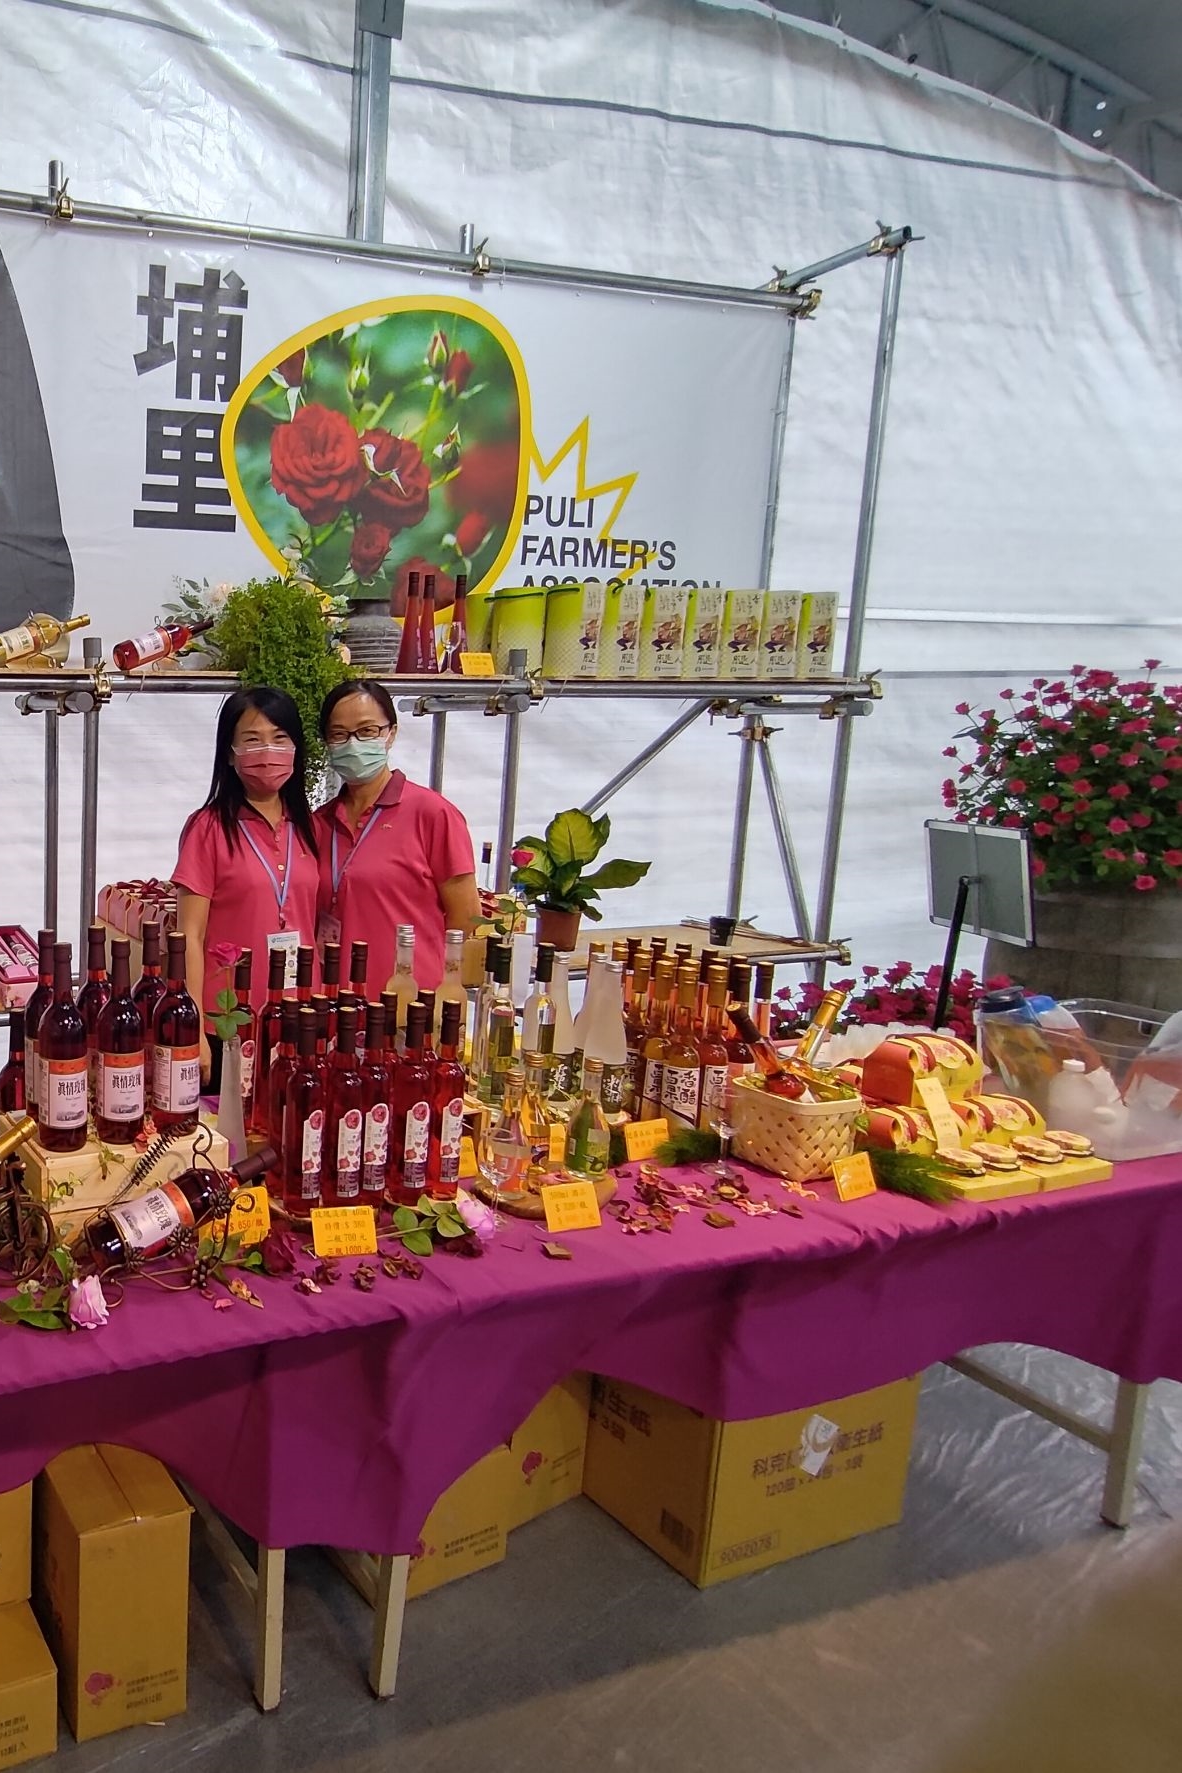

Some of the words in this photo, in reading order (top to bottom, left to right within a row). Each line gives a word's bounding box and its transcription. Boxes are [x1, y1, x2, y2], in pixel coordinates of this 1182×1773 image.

[132, 263, 249, 533] 埔里
[524, 494, 595, 529] PULI
[520, 535, 677, 571] FARMER'S
